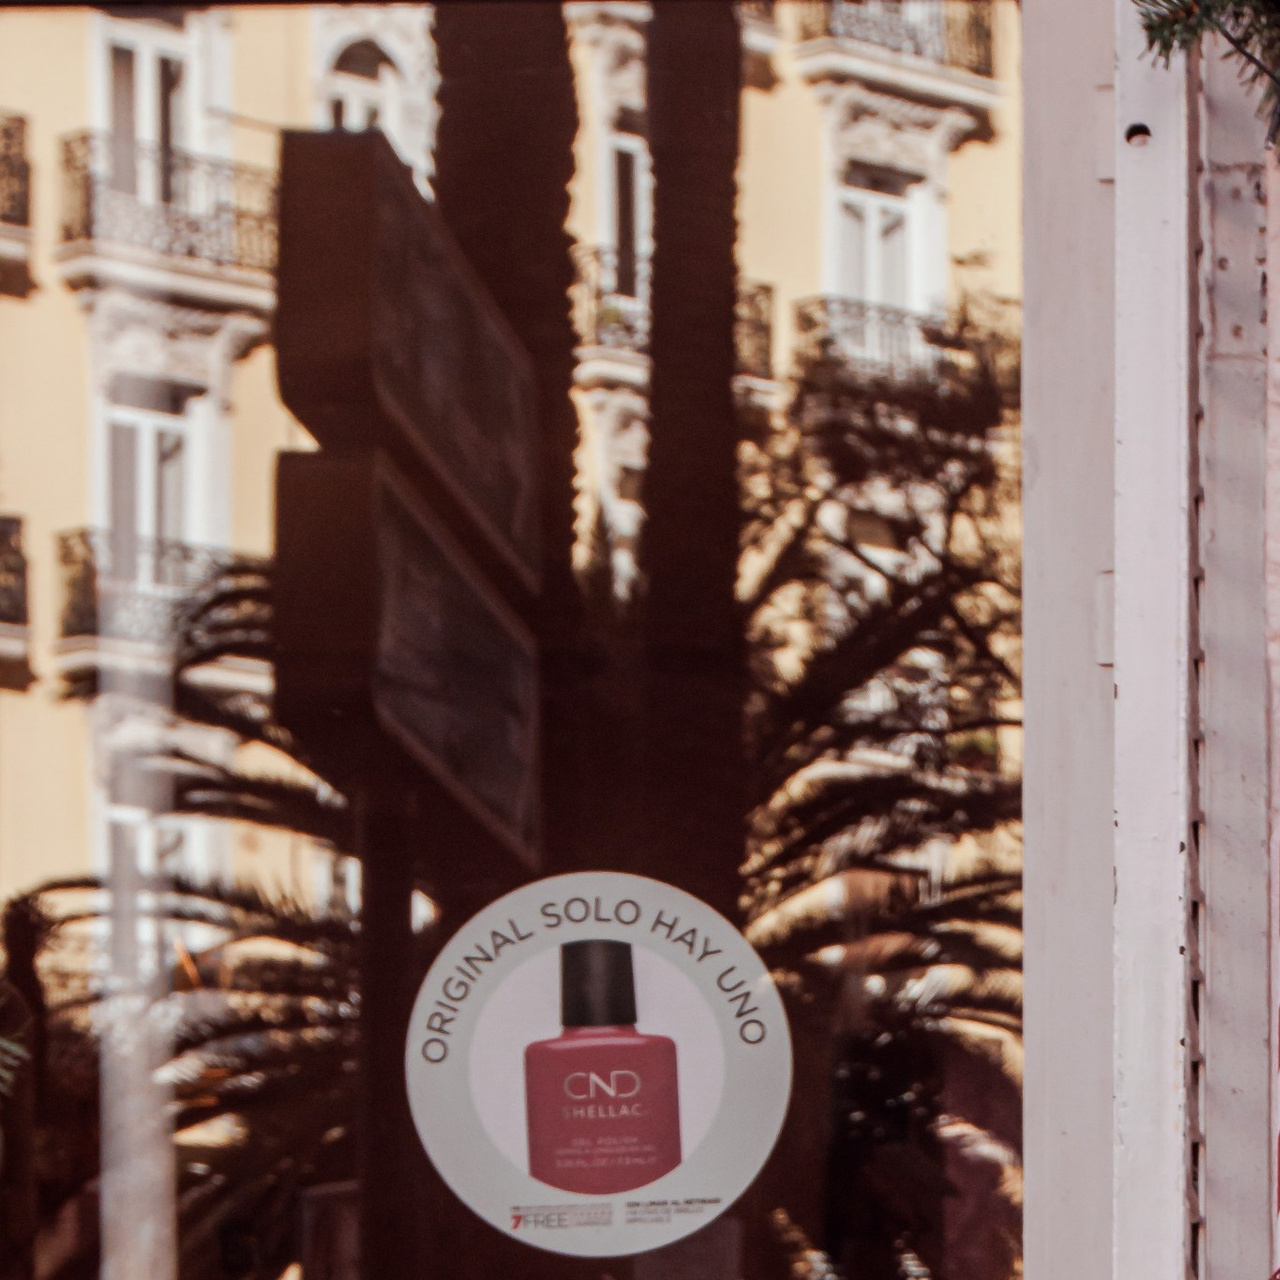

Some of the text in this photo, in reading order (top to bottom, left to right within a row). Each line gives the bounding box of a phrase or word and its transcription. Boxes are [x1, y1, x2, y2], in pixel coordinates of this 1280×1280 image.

[421, 896, 766, 1063] ORIGINAL SOLO HAY UNO
[563, 1070, 641, 1099] CND
